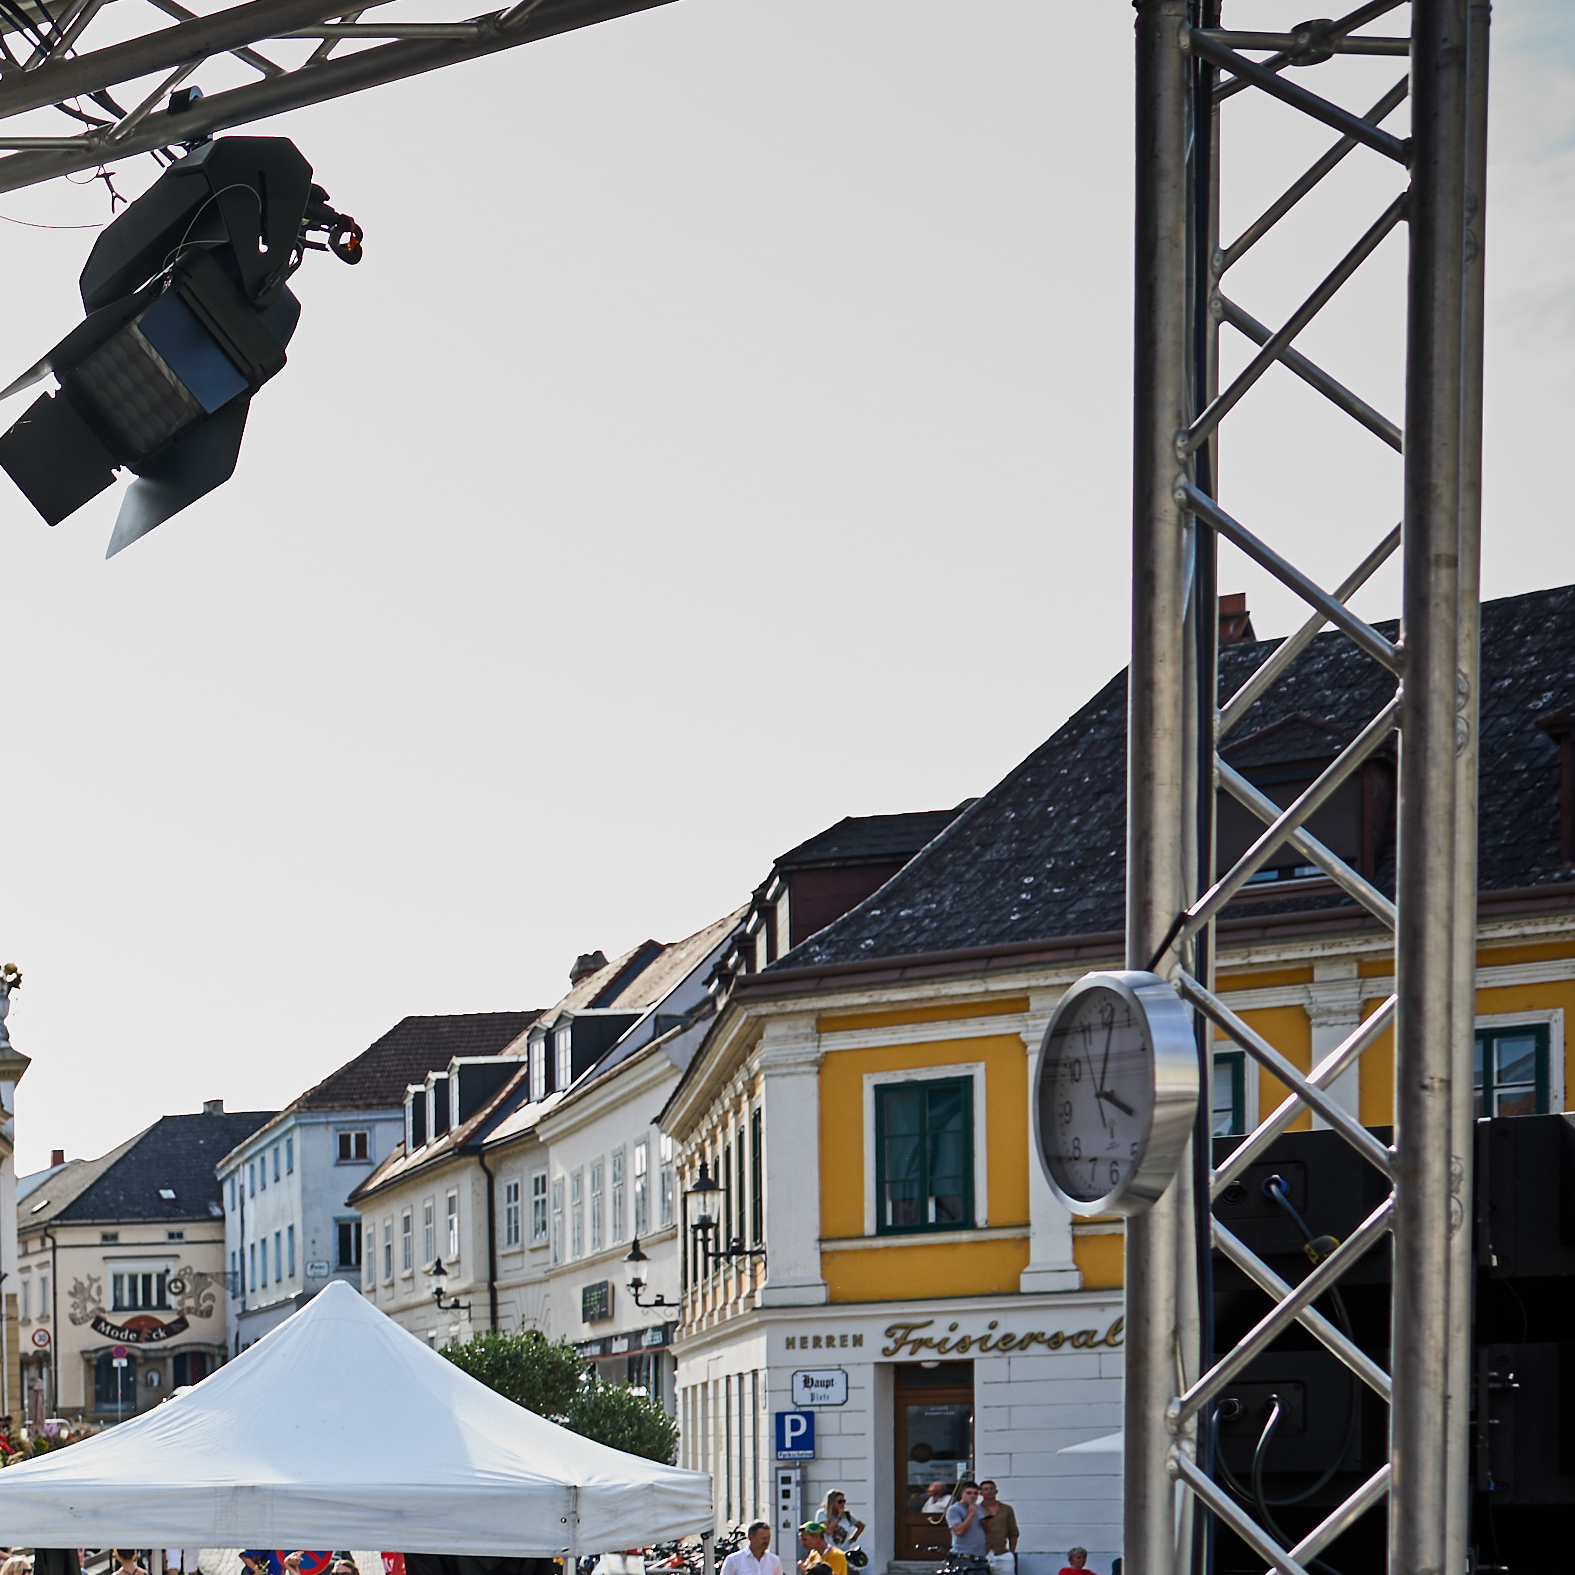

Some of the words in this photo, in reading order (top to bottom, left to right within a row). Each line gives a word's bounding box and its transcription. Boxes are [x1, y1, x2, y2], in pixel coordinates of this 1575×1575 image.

[1069, 1060, 1082, 1085] 10
[1063, 1100, 1073, 1125] 9
[1072, 1137, 1082, 1161] 8
[1088, 1158, 1097, 1182] 7
[1110, 1160, 1119, 1186] 6
[785, 1333, 864, 1350] HERREN
[785, 1414, 807, 1448] P
